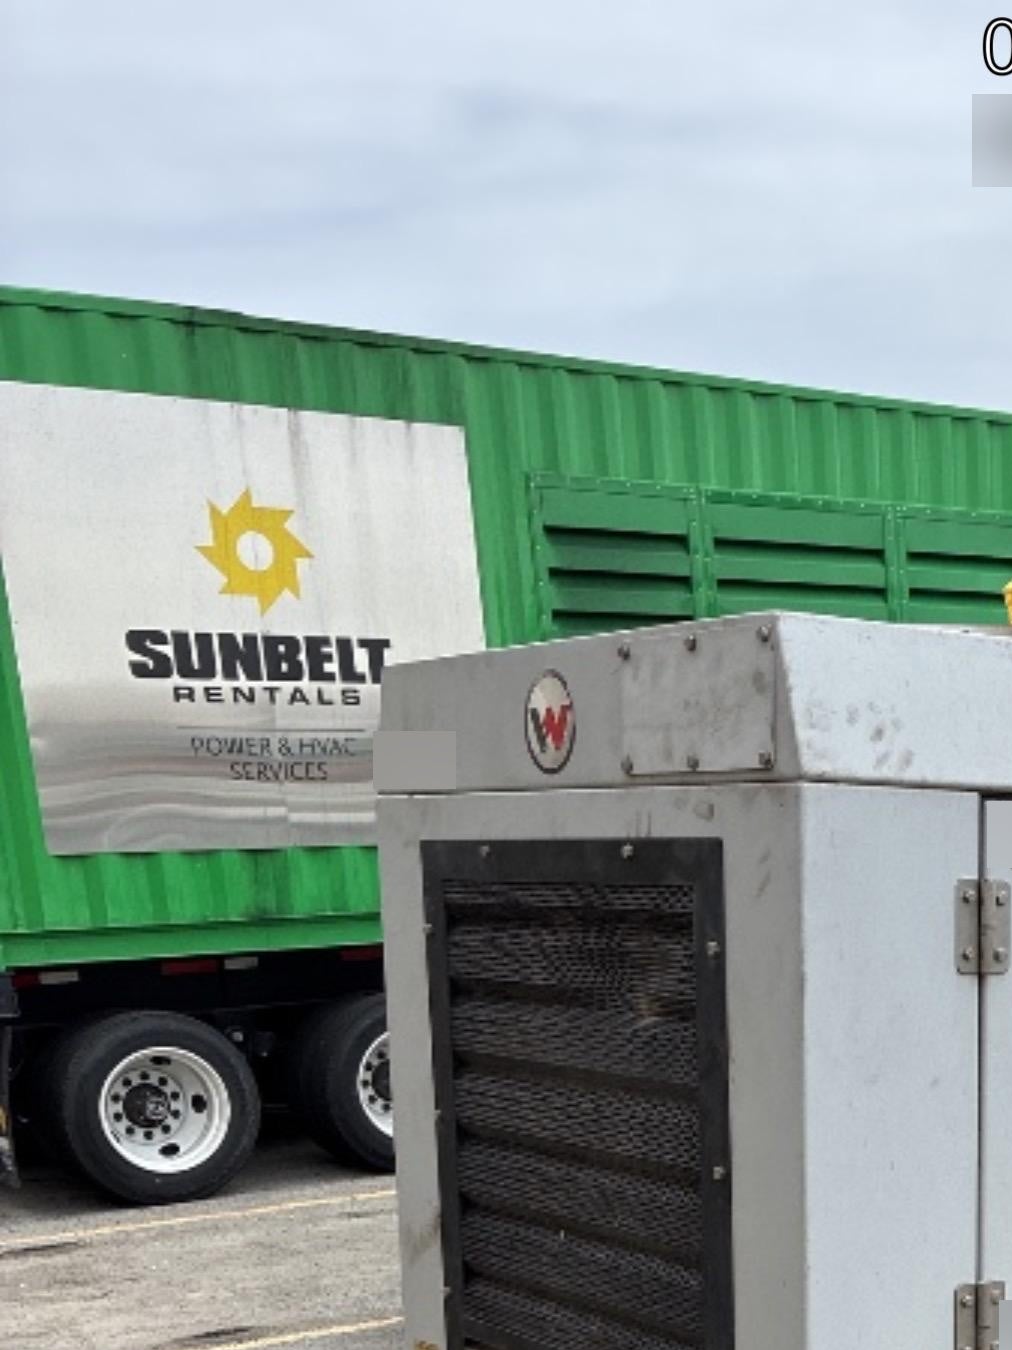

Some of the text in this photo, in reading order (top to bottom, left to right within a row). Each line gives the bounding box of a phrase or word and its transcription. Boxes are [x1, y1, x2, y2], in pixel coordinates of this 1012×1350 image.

[125, 629, 391, 684] SUNBELT
[173, 686, 362, 706] RENTALS
[190, 736, 358, 757] POWER & HVAC
[230, 761, 329, 782] SERVICES
